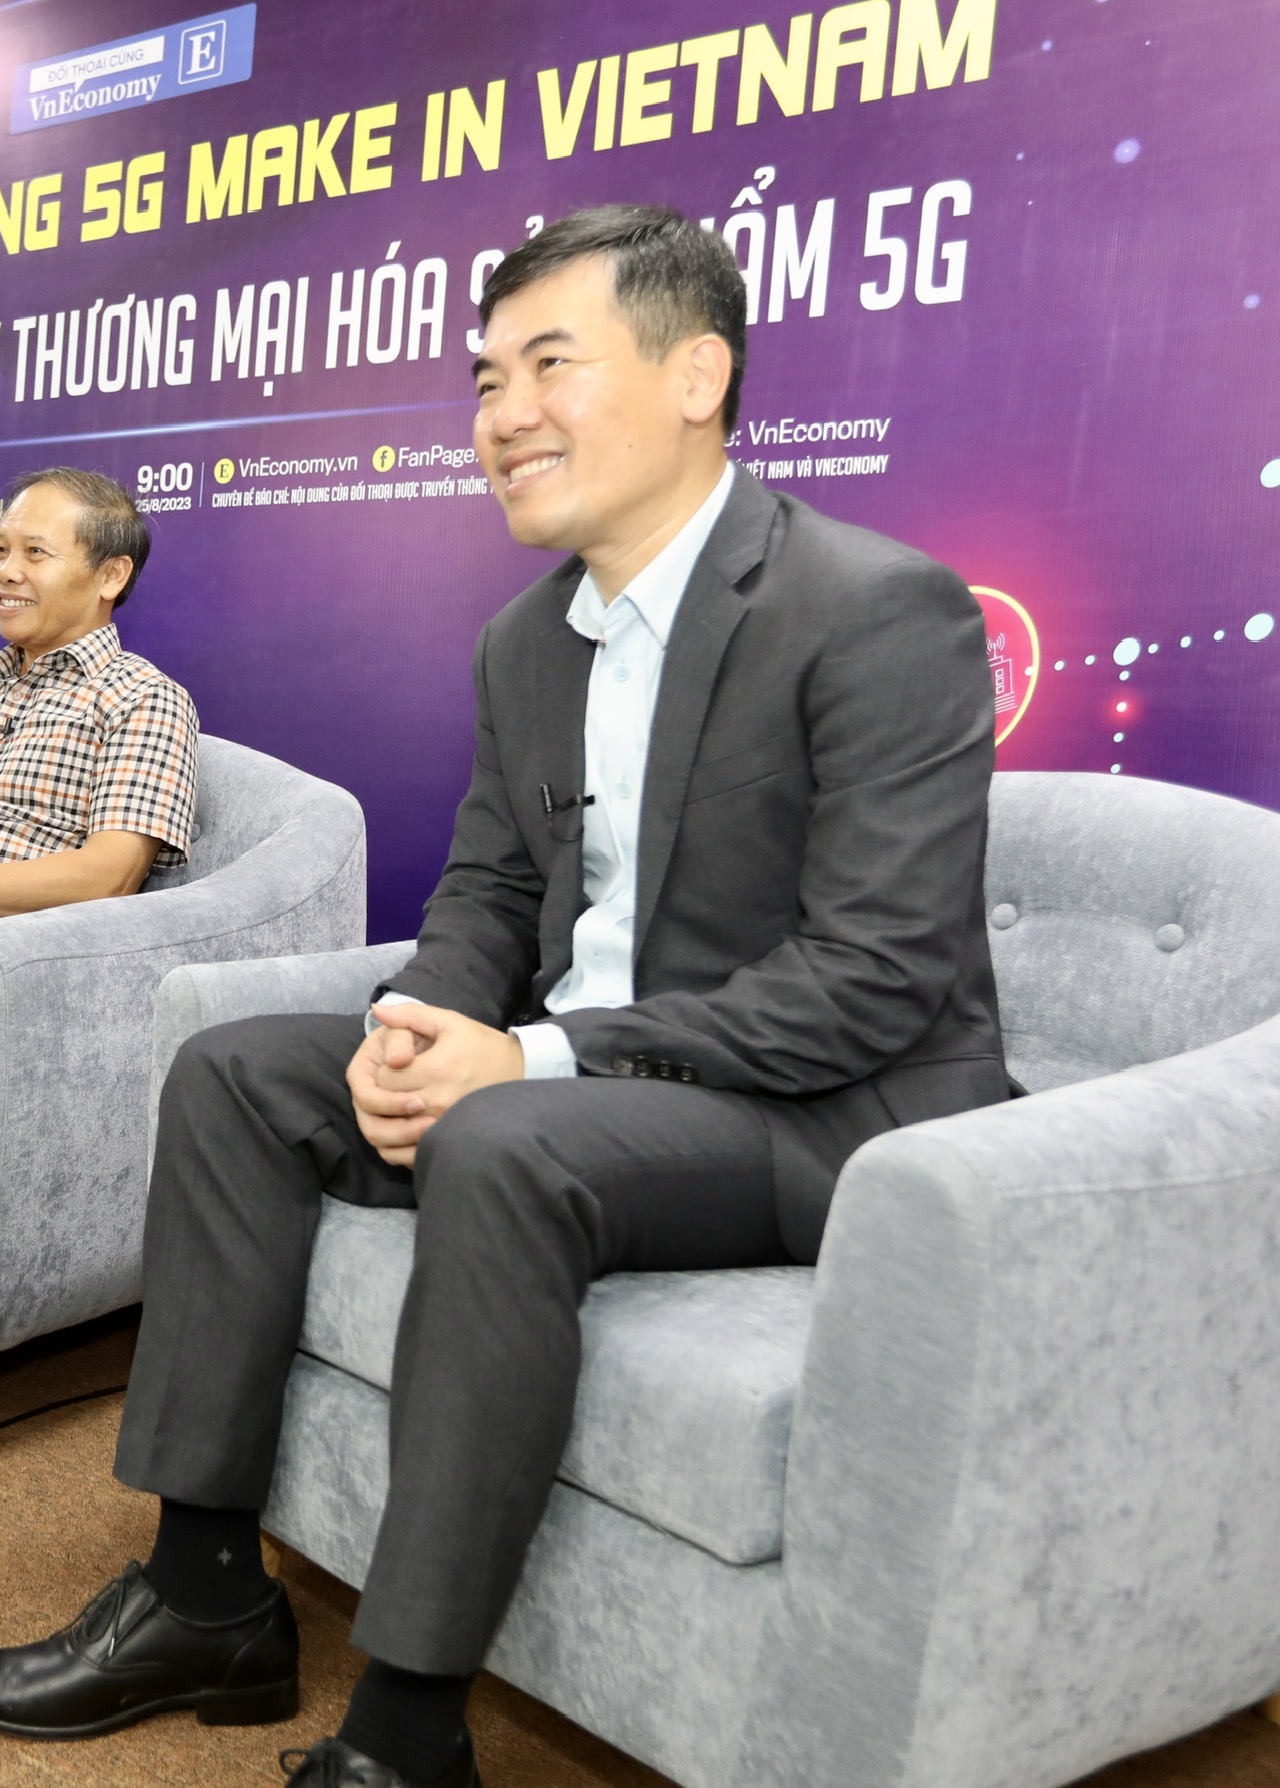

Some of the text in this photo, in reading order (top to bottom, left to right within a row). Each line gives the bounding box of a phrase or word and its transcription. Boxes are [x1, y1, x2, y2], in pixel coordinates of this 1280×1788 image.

[185, 31, 216, 75] E
[29, 74, 162, 121] VnEconomy
[81, 151, 165, 243] 5G
[185, 102, 398, 224] MAKE
[421, 79, 505, 182] IN
[538, 0, 997, 160] VIETNAM
[13, 294, 196, 402] THƯƠNG
[210, 276, 308, 396] MẠI
[325, 241, 448, 370] HÓA
[860, 180, 972, 312] 5G
[748, 417, 891, 445] VnEconomy
[137, 462, 193, 493] 9:00
[239, 455, 358, 478] VnEconomy.vn
[767, 460, 794, 479] NAM
[796, 456, 813, 478] VÀ
[815, 454, 889, 477] VNECONOMY
[135, 496, 192, 514] 25/8/2023
[212, 489, 242, 508] CHUYÊN
[255, 487, 271, 506] BÁO
[291, 486, 306, 506] NỘI
[307, 486, 330, 503] DUNG
[331, 483, 349, 502] CỦA
[350, 480, 365, 501] ĐỐI
[368, 482, 393, 502] THOẠI
[394, 480, 419, 501] ĐƯỢC
[457, 475, 487, 496] THÔNG
